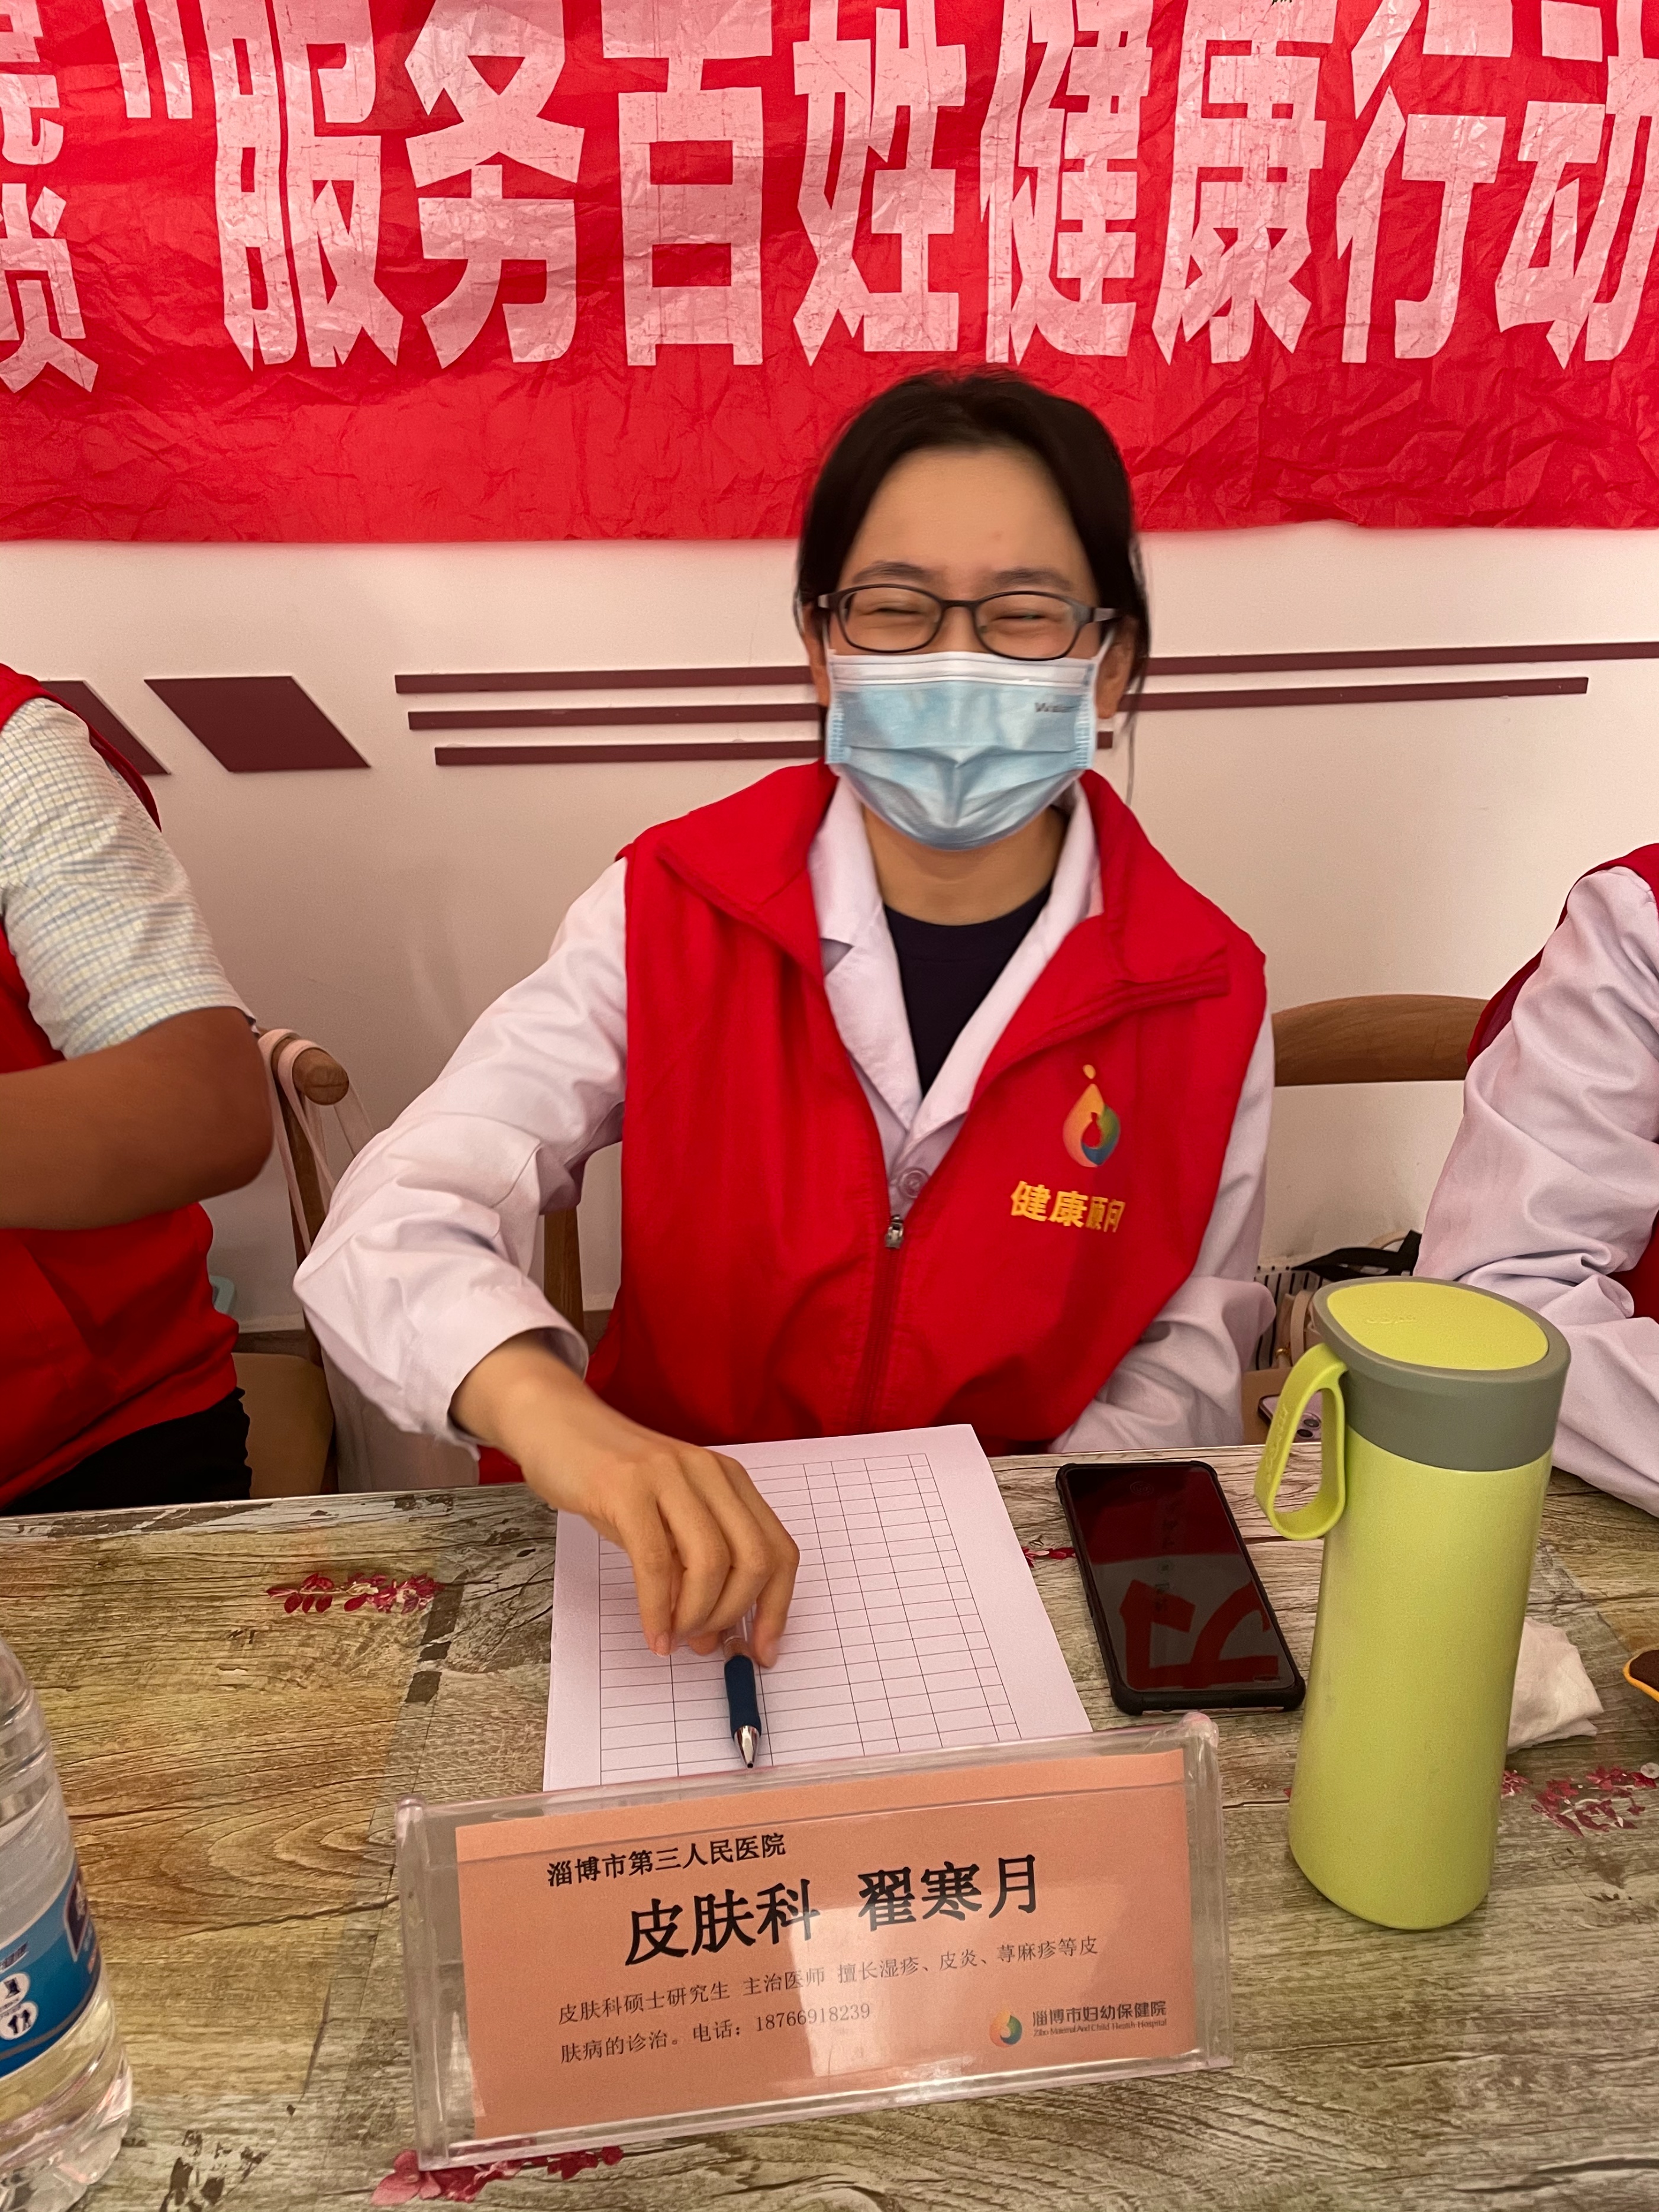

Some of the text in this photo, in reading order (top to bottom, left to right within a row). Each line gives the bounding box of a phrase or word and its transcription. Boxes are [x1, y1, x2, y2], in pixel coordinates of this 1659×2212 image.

[547, 1833, 787, 1887] 淄博市第三人民医院
[625, 1854, 1037, 1966] 皮肤科 翟寒月
[558, 1981, 731, 2025] 皮肤科硕士研究生
[742, 1966, 825, 1997] 主治医师
[1032, 2000, 1167, 2027] 淄博市妇幼保健院
